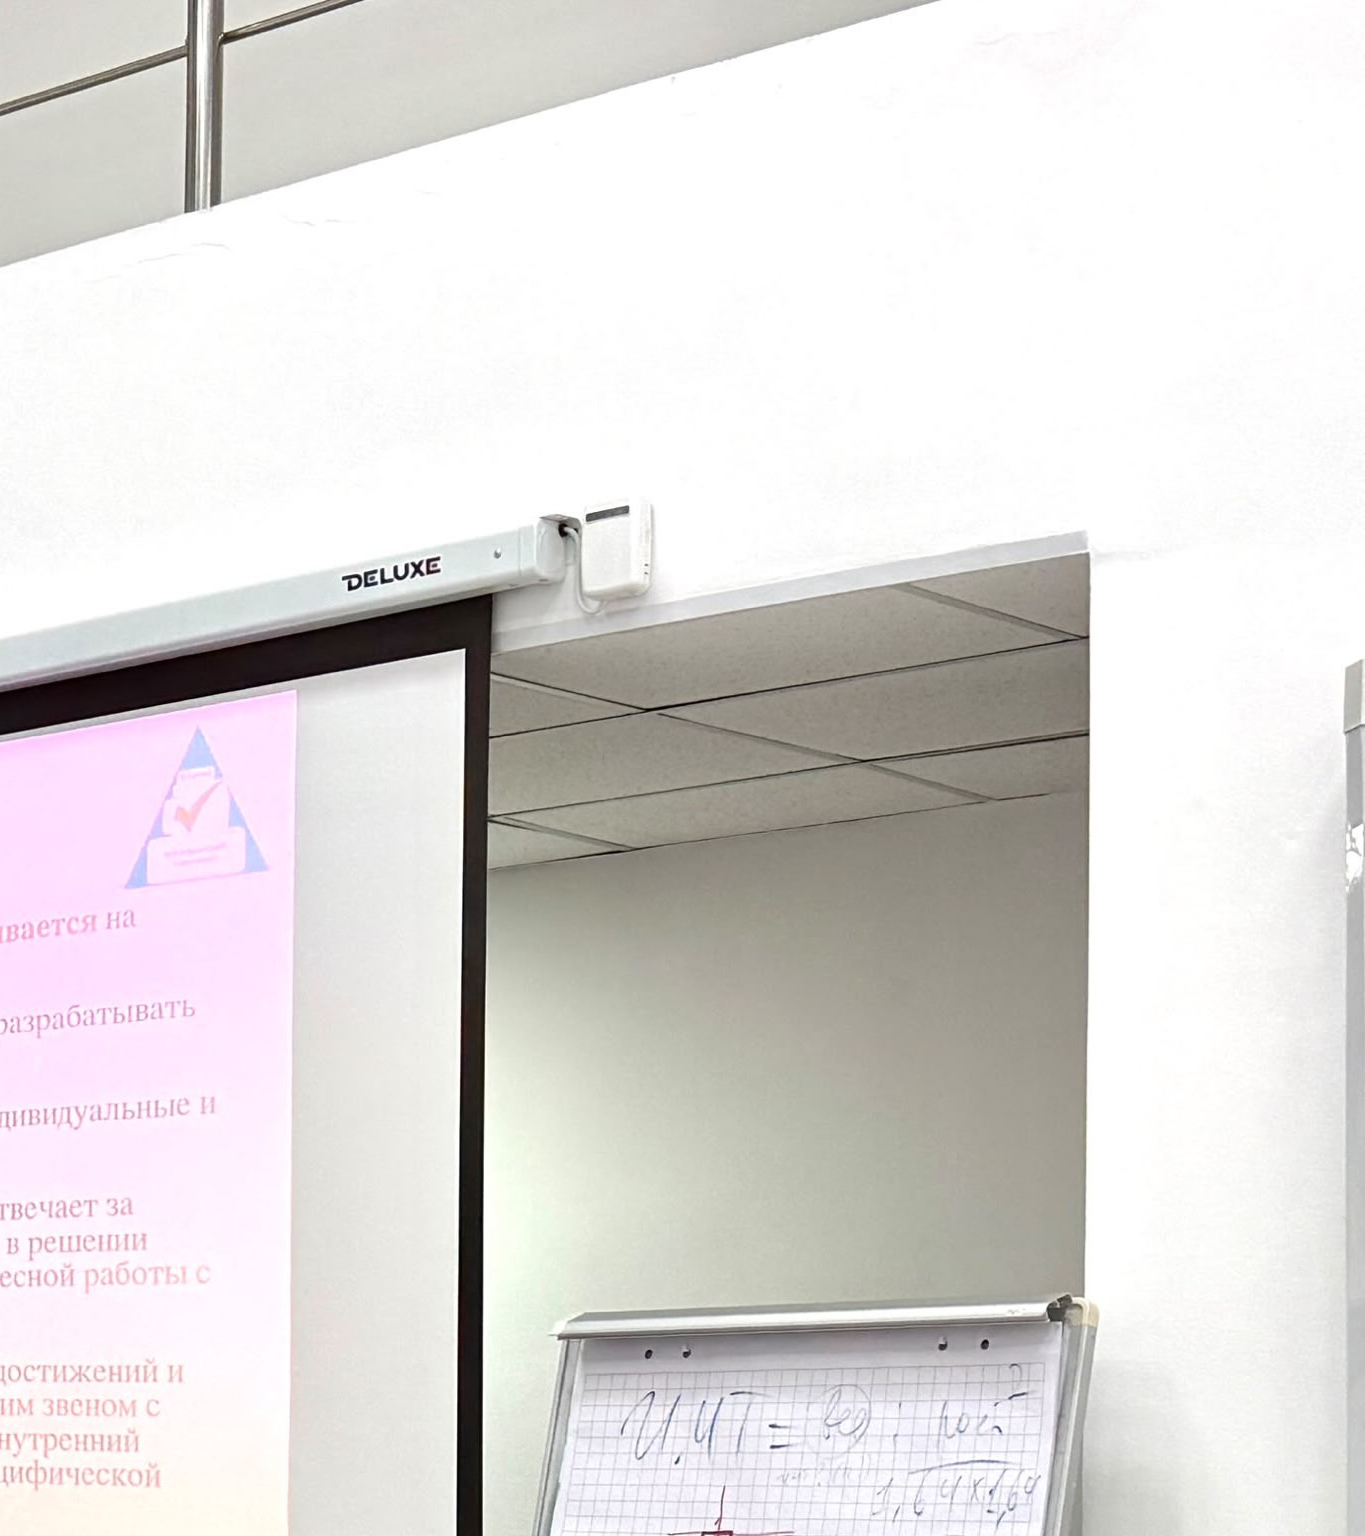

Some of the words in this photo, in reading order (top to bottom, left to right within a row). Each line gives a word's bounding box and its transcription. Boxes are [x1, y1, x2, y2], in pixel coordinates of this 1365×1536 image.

[341, 556, 441, 592] DELUXE
[105, 908, 136, 931] на
[199, 1095, 216, 1116] и
[106, 1196, 134, 1217] за
[7, 1237, 20, 1255] в
[28, 1232, 148, 1261] решении
[84, 1260, 188, 1295] работы
[196, 1264, 211, 1285] с
[167, 1364, 184, 1383] и
[42, 1398, 137, 1418] звеном
[145, 1398, 161, 1417] с
